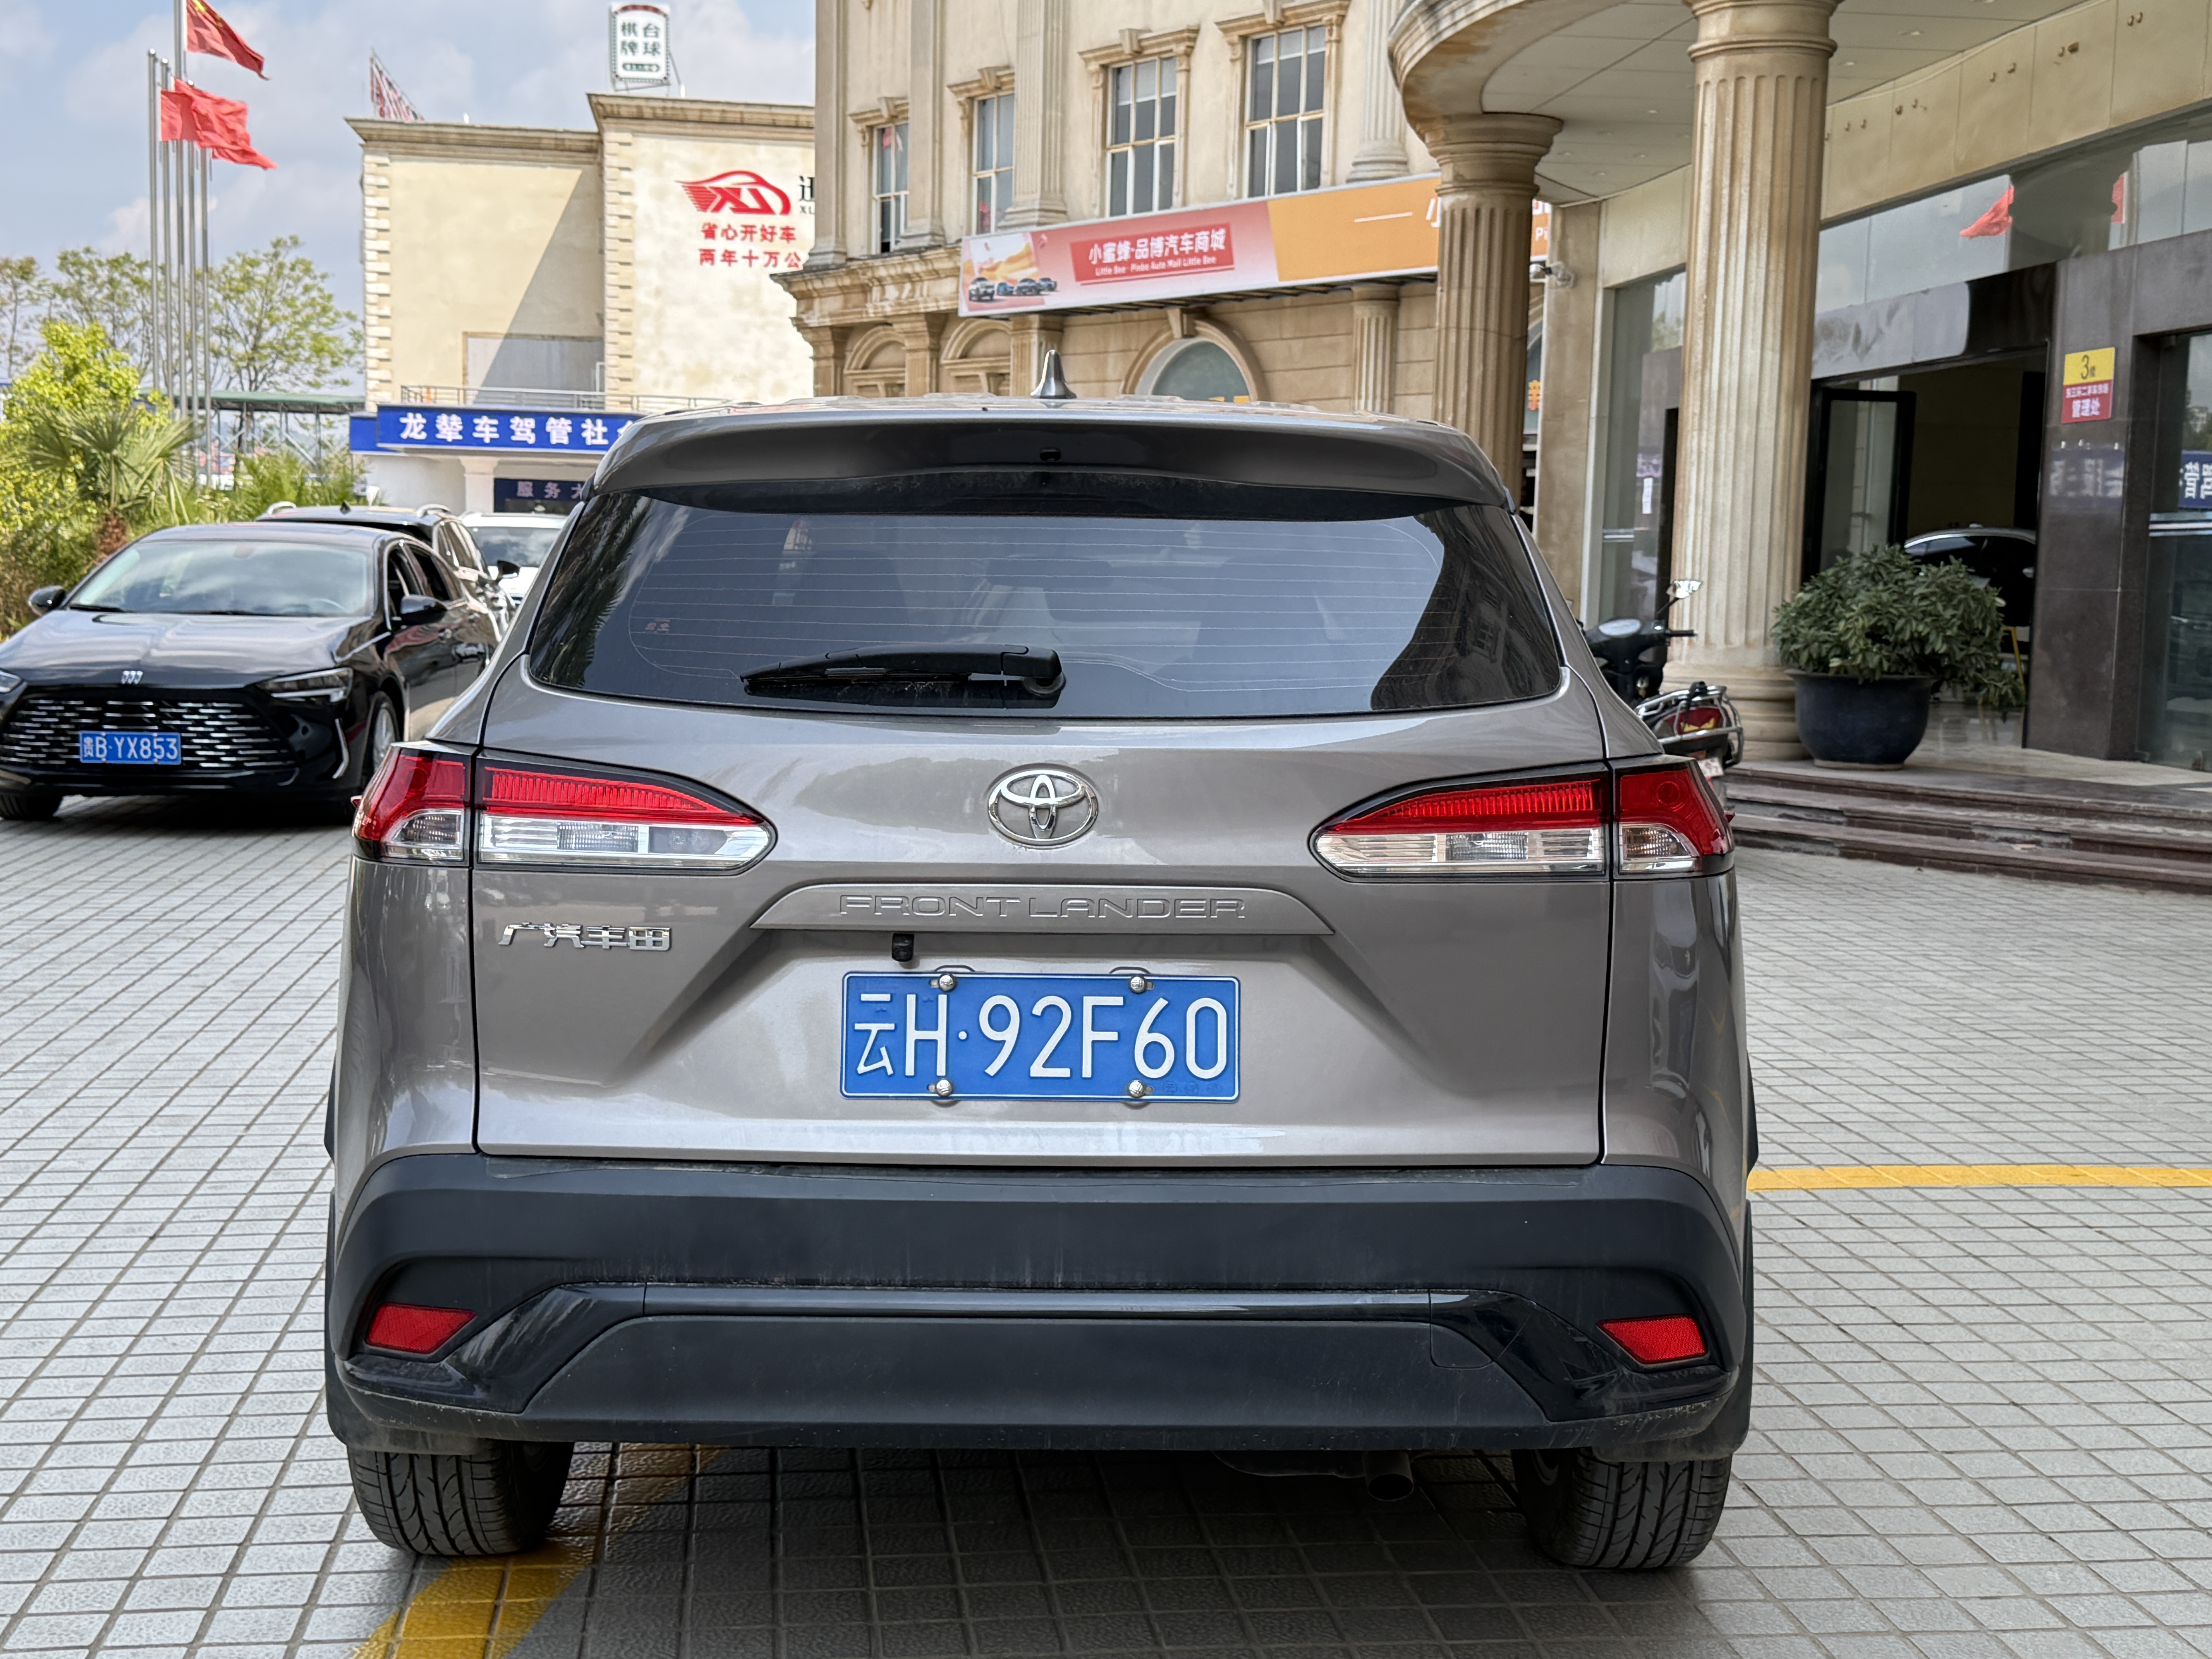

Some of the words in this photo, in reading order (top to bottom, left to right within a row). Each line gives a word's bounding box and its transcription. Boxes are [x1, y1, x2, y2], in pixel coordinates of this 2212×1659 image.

[642, 23, 661, 56] 台球
[701, 222, 797, 244] 省心开好车
[699, 249, 802, 268] 两年十万公
[399, 412, 633, 445] 龙辇车驾管社
[498, 922, 670, 951] 广汽丰田
[854, 993, 1227, 1079] 云H·92F60
